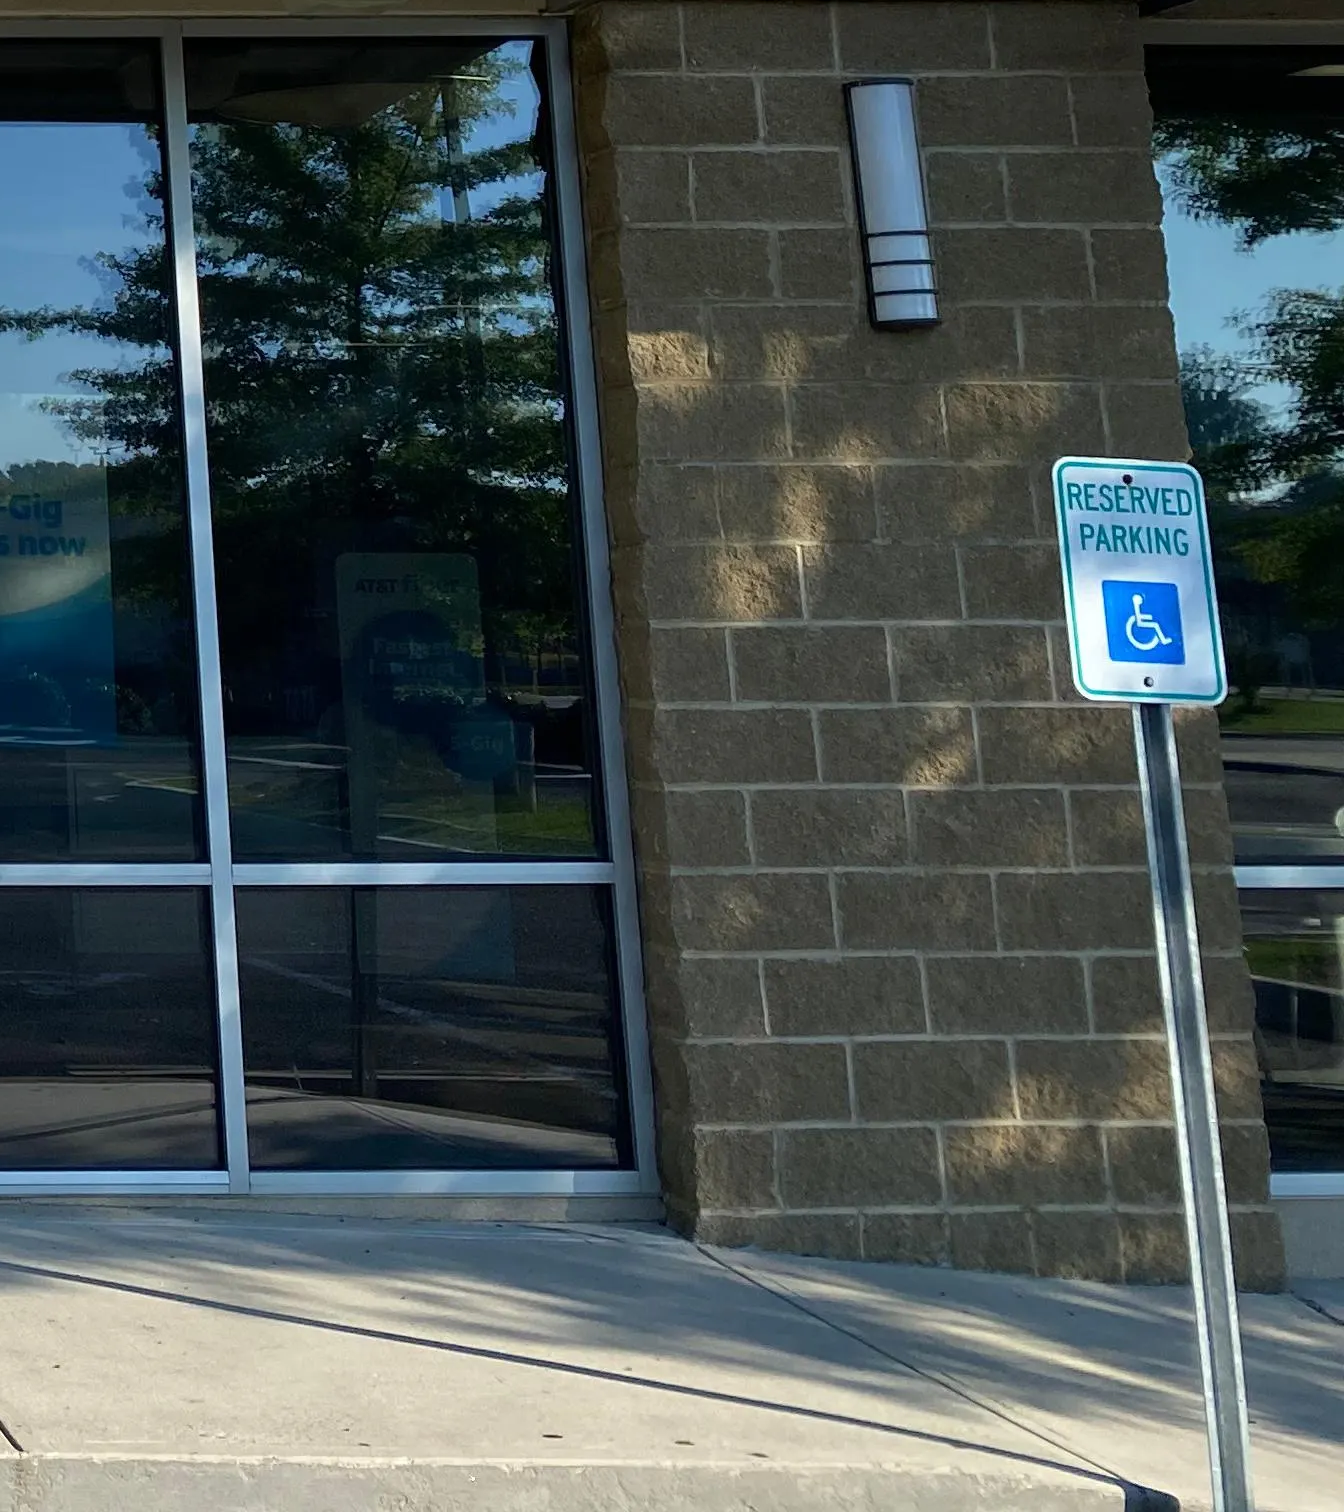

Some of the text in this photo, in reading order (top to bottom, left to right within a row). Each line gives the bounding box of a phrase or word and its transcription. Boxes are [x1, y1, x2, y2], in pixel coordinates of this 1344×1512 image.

[1066, 482, 1193, 516] RESERVED
[17, 535, 87, 557] now
[1079, 523, 1189, 557] PARKING
